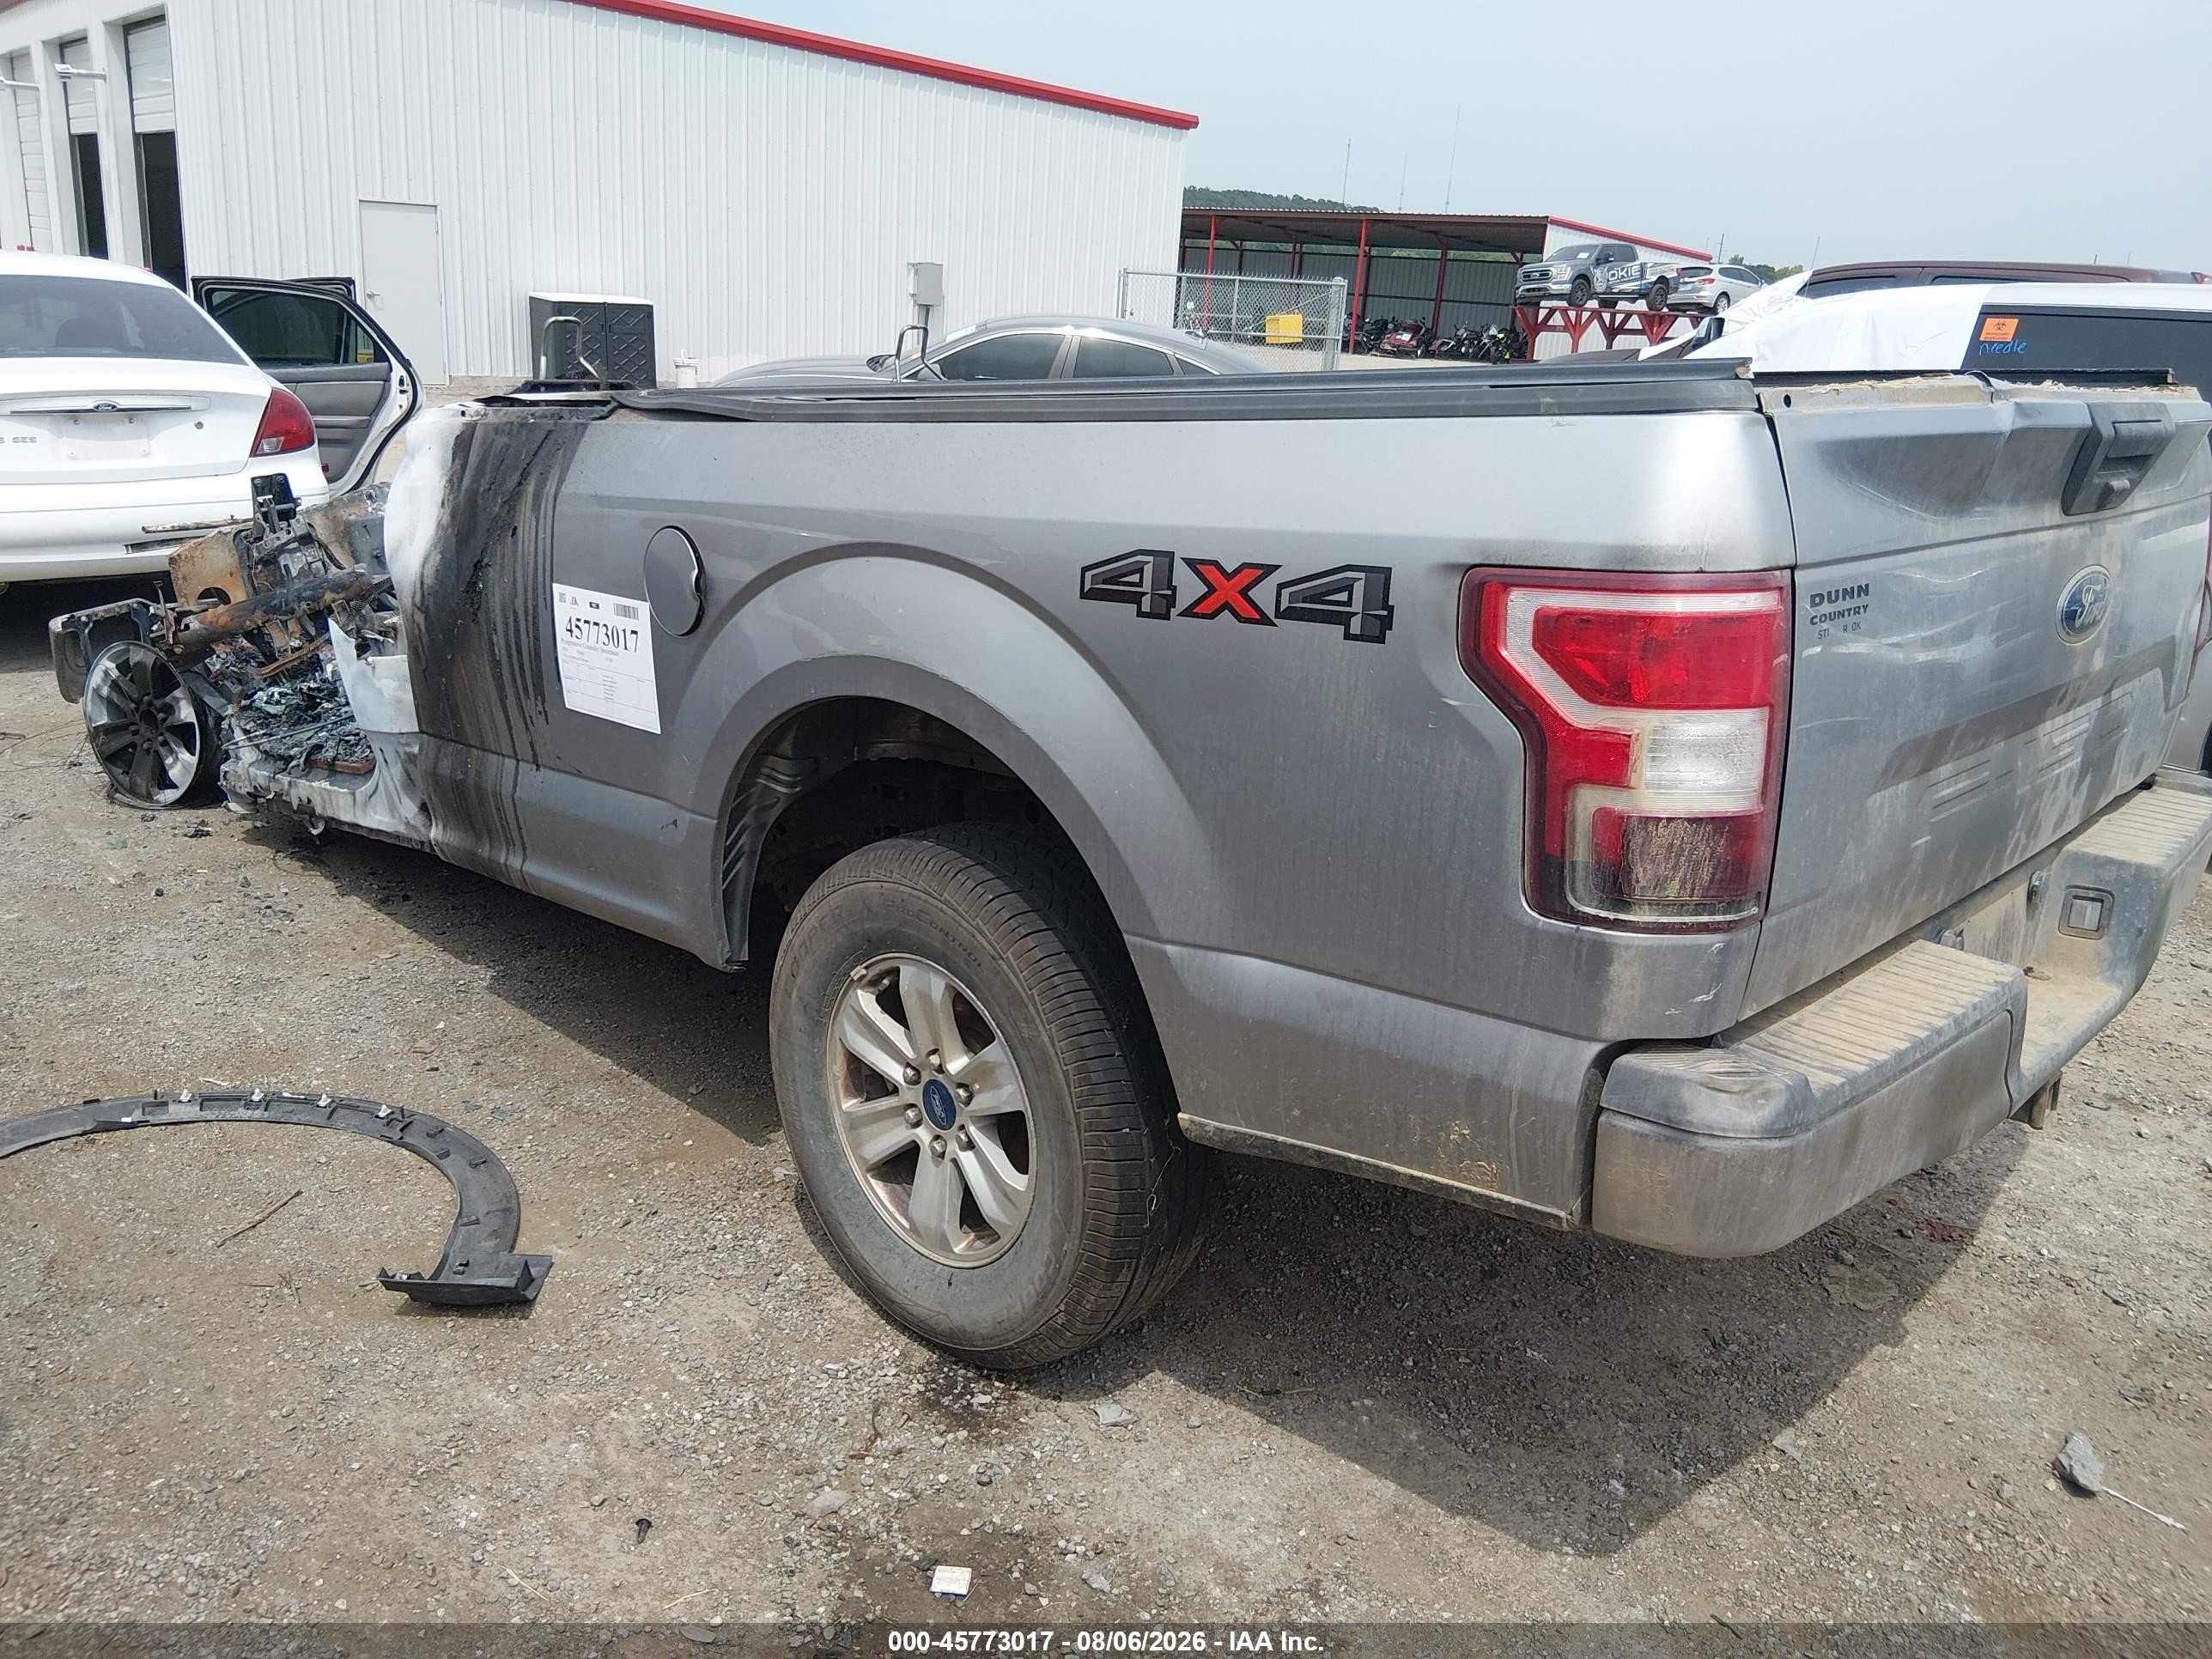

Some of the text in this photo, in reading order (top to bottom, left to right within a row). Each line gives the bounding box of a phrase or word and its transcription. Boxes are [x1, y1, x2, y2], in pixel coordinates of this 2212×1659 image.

[1608, 265, 1641, 281] OKIE
[1979, 339, 2027, 356] needle
[1809, 583, 1869, 609] DUNN
[2064, 583, 2108, 628] Ford
[1809, 604, 1869, 626] COUNTRY
[565, 616, 639, 653] 45773017
